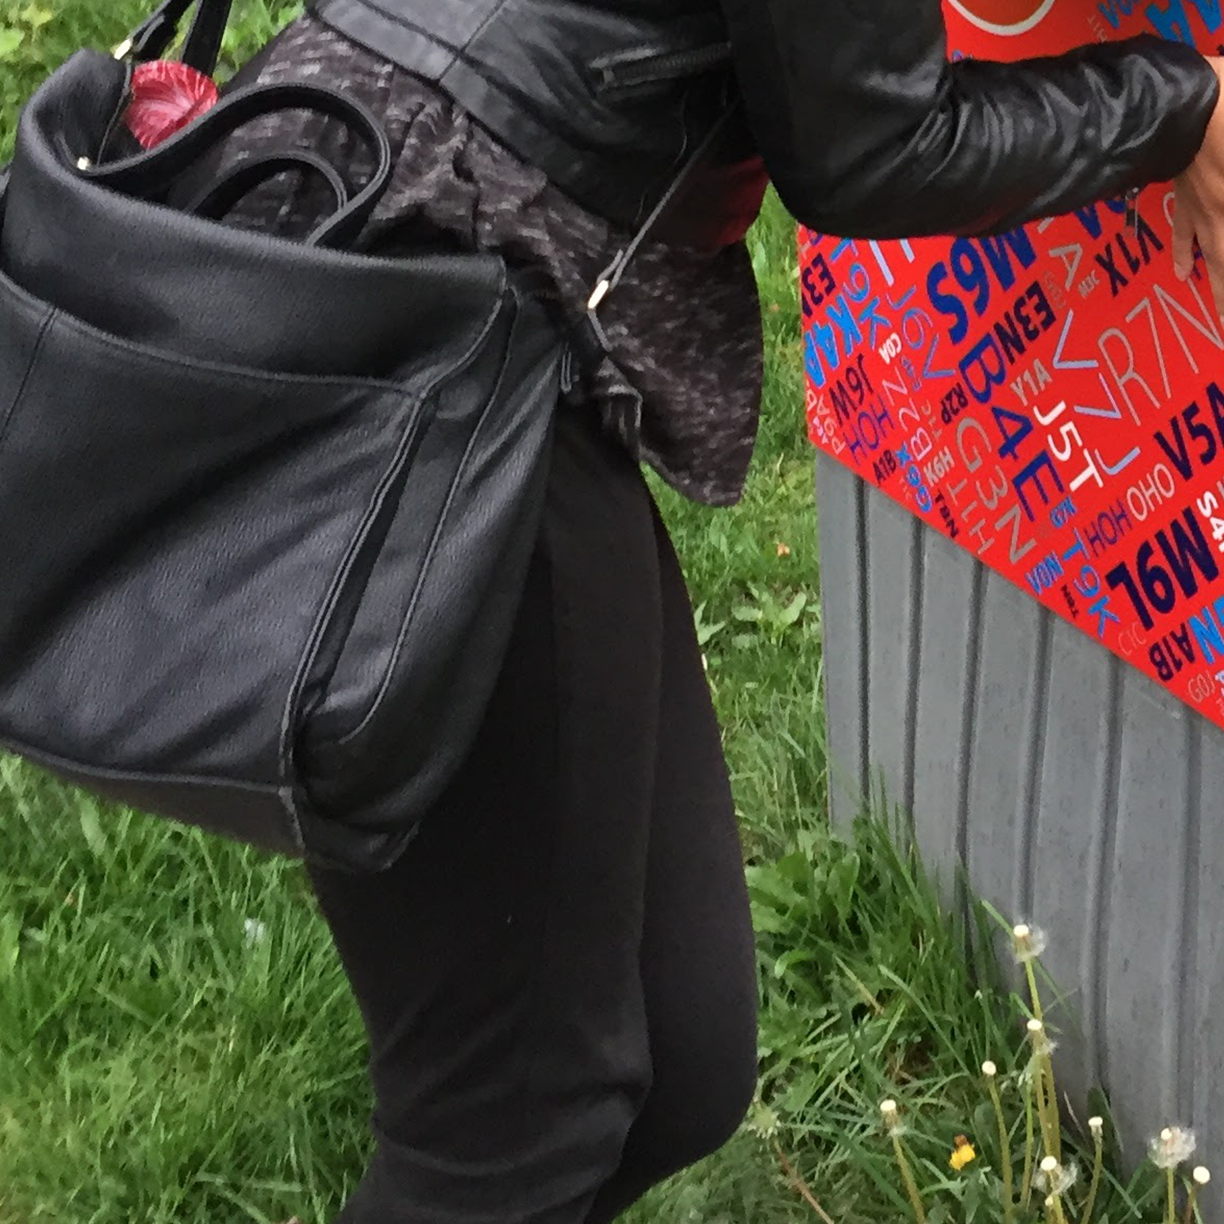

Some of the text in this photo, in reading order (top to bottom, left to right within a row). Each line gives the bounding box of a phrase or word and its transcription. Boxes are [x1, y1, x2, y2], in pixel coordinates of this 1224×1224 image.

[1009, 358, 1054, 408] Y1A
[957, 330, 1066, 524] B4E
[1032, 399, 1105, 493] J5T
[872, 449, 898, 486] A1B
[922, 445, 956, 488] K6H
